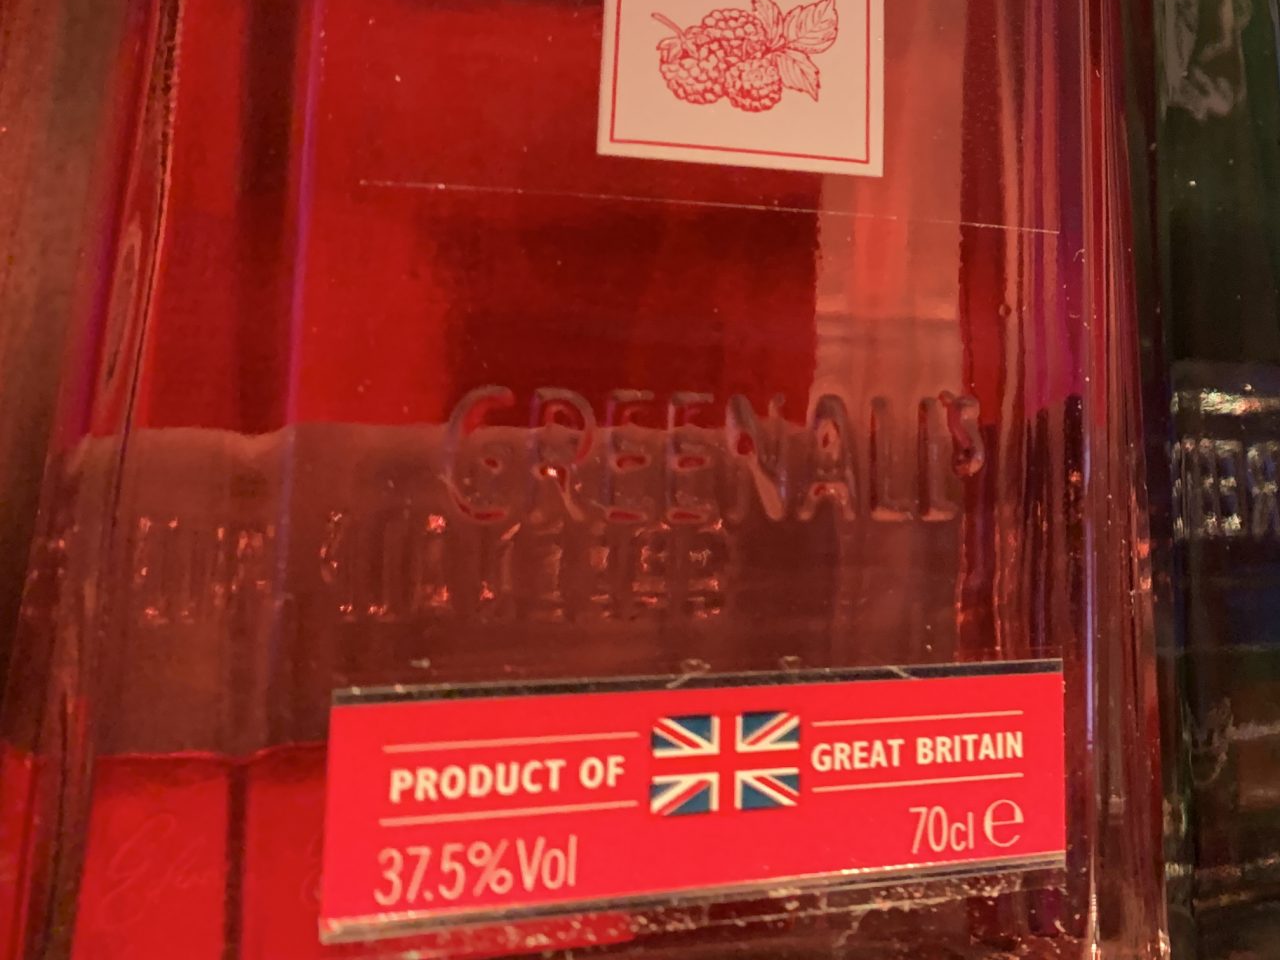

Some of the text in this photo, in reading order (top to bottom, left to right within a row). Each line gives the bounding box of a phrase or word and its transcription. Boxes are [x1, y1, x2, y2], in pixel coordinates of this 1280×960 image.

[810, 731, 1025, 773] GREAT BRITAIN
[388, 754, 626, 804] PRODUCT OF
[908, 806, 976, 855] 70cl
